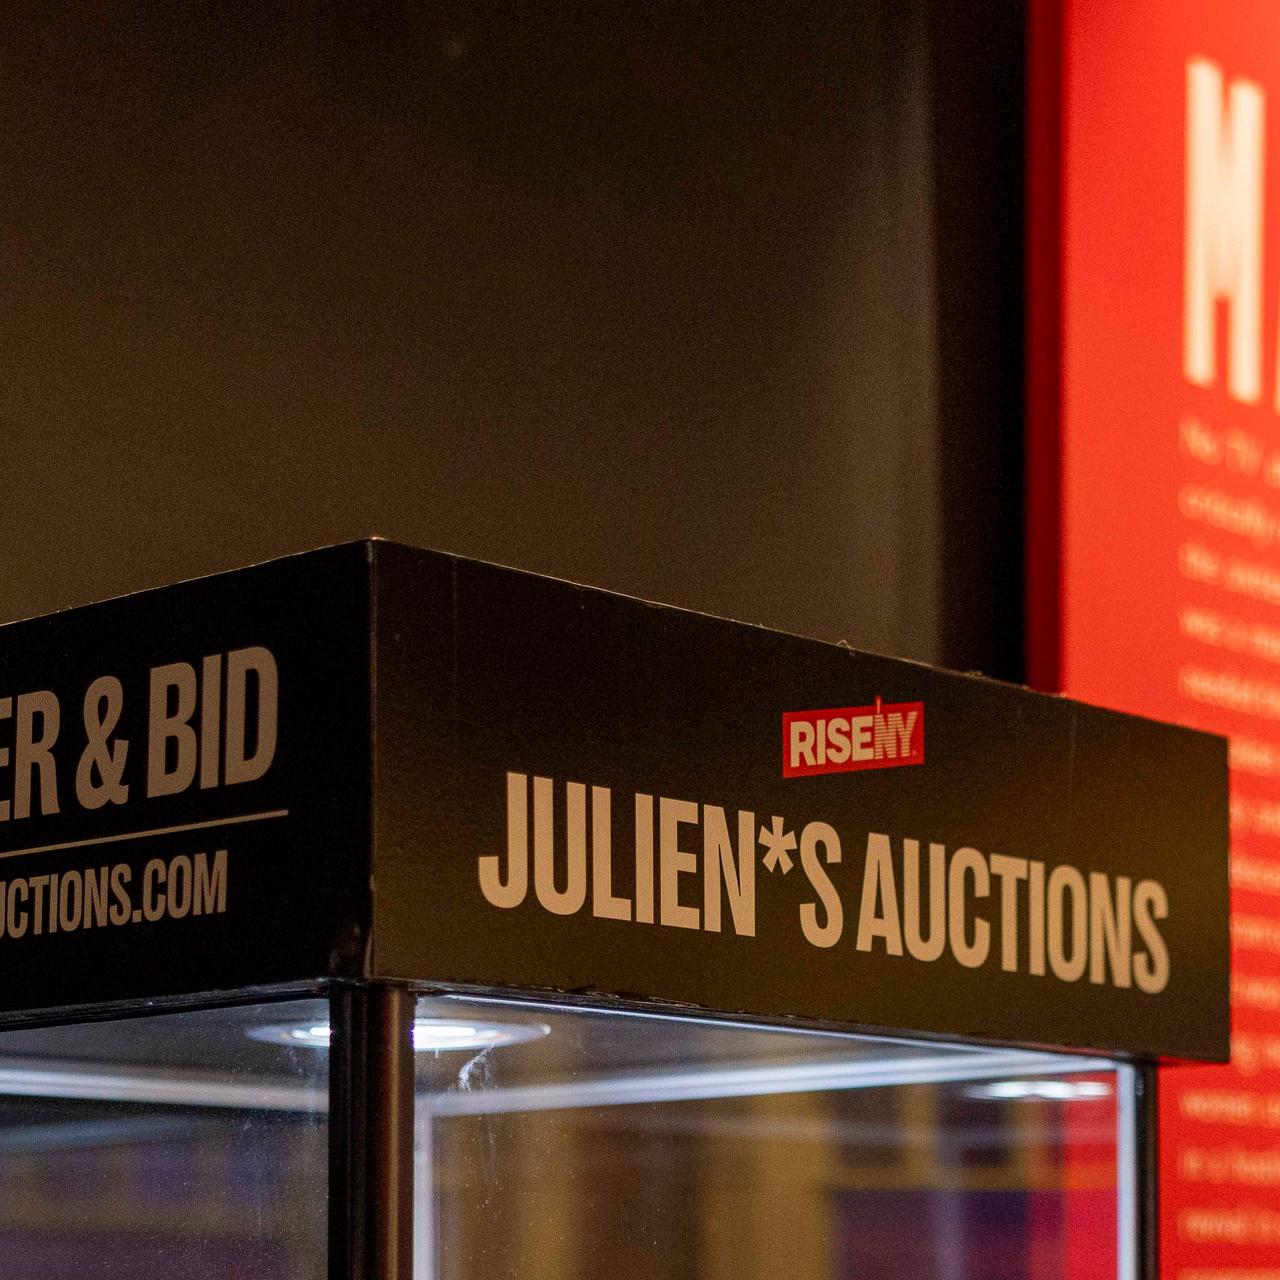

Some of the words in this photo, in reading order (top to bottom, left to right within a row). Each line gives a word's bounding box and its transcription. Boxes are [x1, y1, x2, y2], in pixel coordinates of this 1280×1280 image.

[75, 675, 129, 810] &
[147, 646, 280, 800] BID
[855, 832, 1170, 994] AUCTIONS
